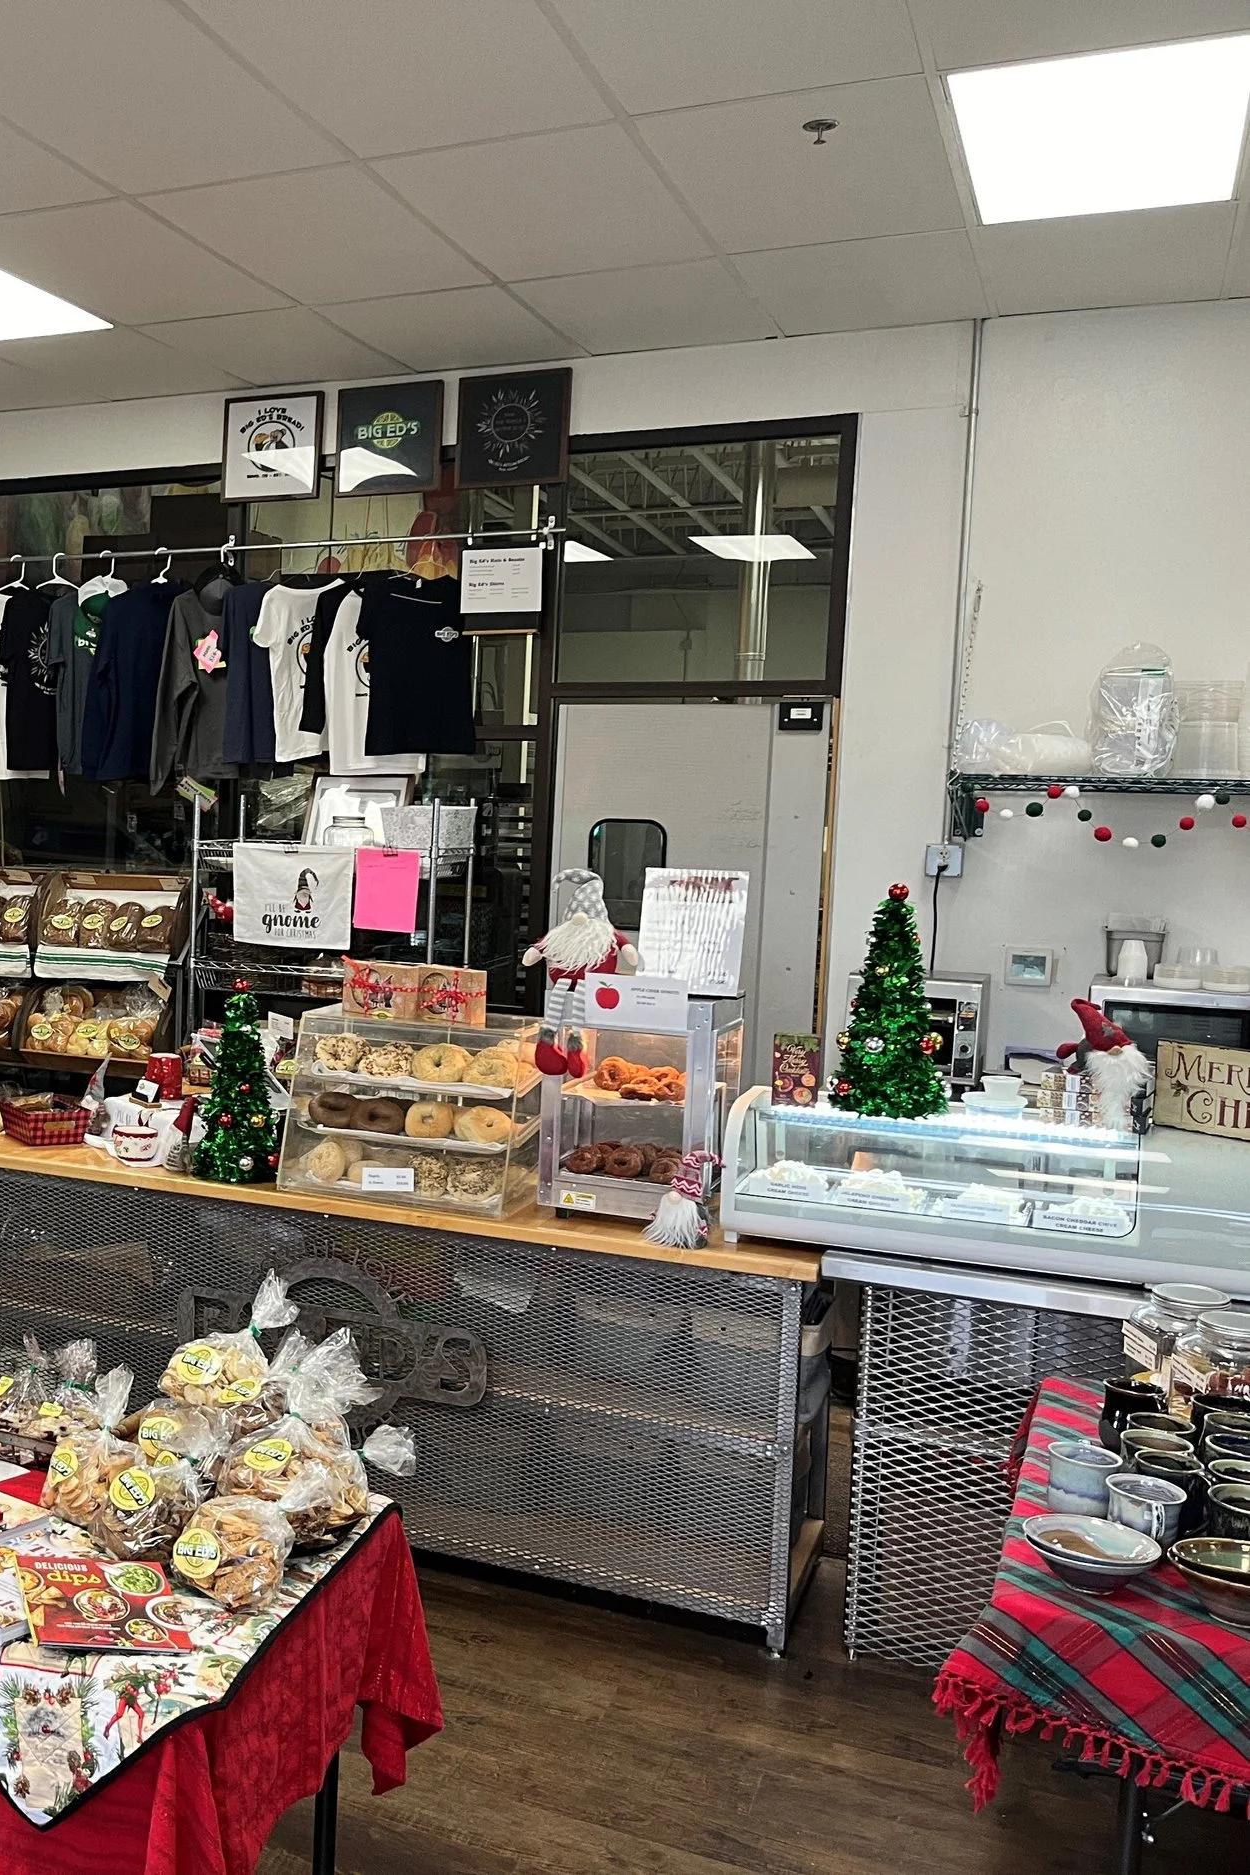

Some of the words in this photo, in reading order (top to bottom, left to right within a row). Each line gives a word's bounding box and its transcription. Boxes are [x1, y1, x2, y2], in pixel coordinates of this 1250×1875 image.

[263, 406, 288, 415] LOVE
[240, 419, 255, 434] BIG
[255, 413, 274, 424] ED'S
[276, 413, 305, 432] BREAD!
[357, 423, 383, 440] BIG
[385, 421, 419, 438] ED'S
[287, 631, 299, 645] BIG
[264, 903, 276, 913] I'LL
[278, 903, 287, 912] BE
[262, 912, 321, 934] gnome
[274, 928, 285, 937] FOR
[286, 929, 317, 940] CHRISTMAS
[1165, 1051, 1250, 1095] MER
[1186, 1089, 1250, 1129] CH
[1042, 1214, 1065, 1222] BACON
[1066, 1216, 1096, 1226] CHEDDAR
[1055, 1222, 1078, 1231] CREAM
[1079, 1225, 1104, 1233] CHEESE
[142, 1427, 159, 1440] BIG
[119, 1472, 135, 1491] BIG
[132, 1484, 149, 1505] ED'S
[177, 1542, 194, 1556] BIG
[34, 1561, 88, 1572] DELICIOUS
[46, 1569, 102, 1586] dips
